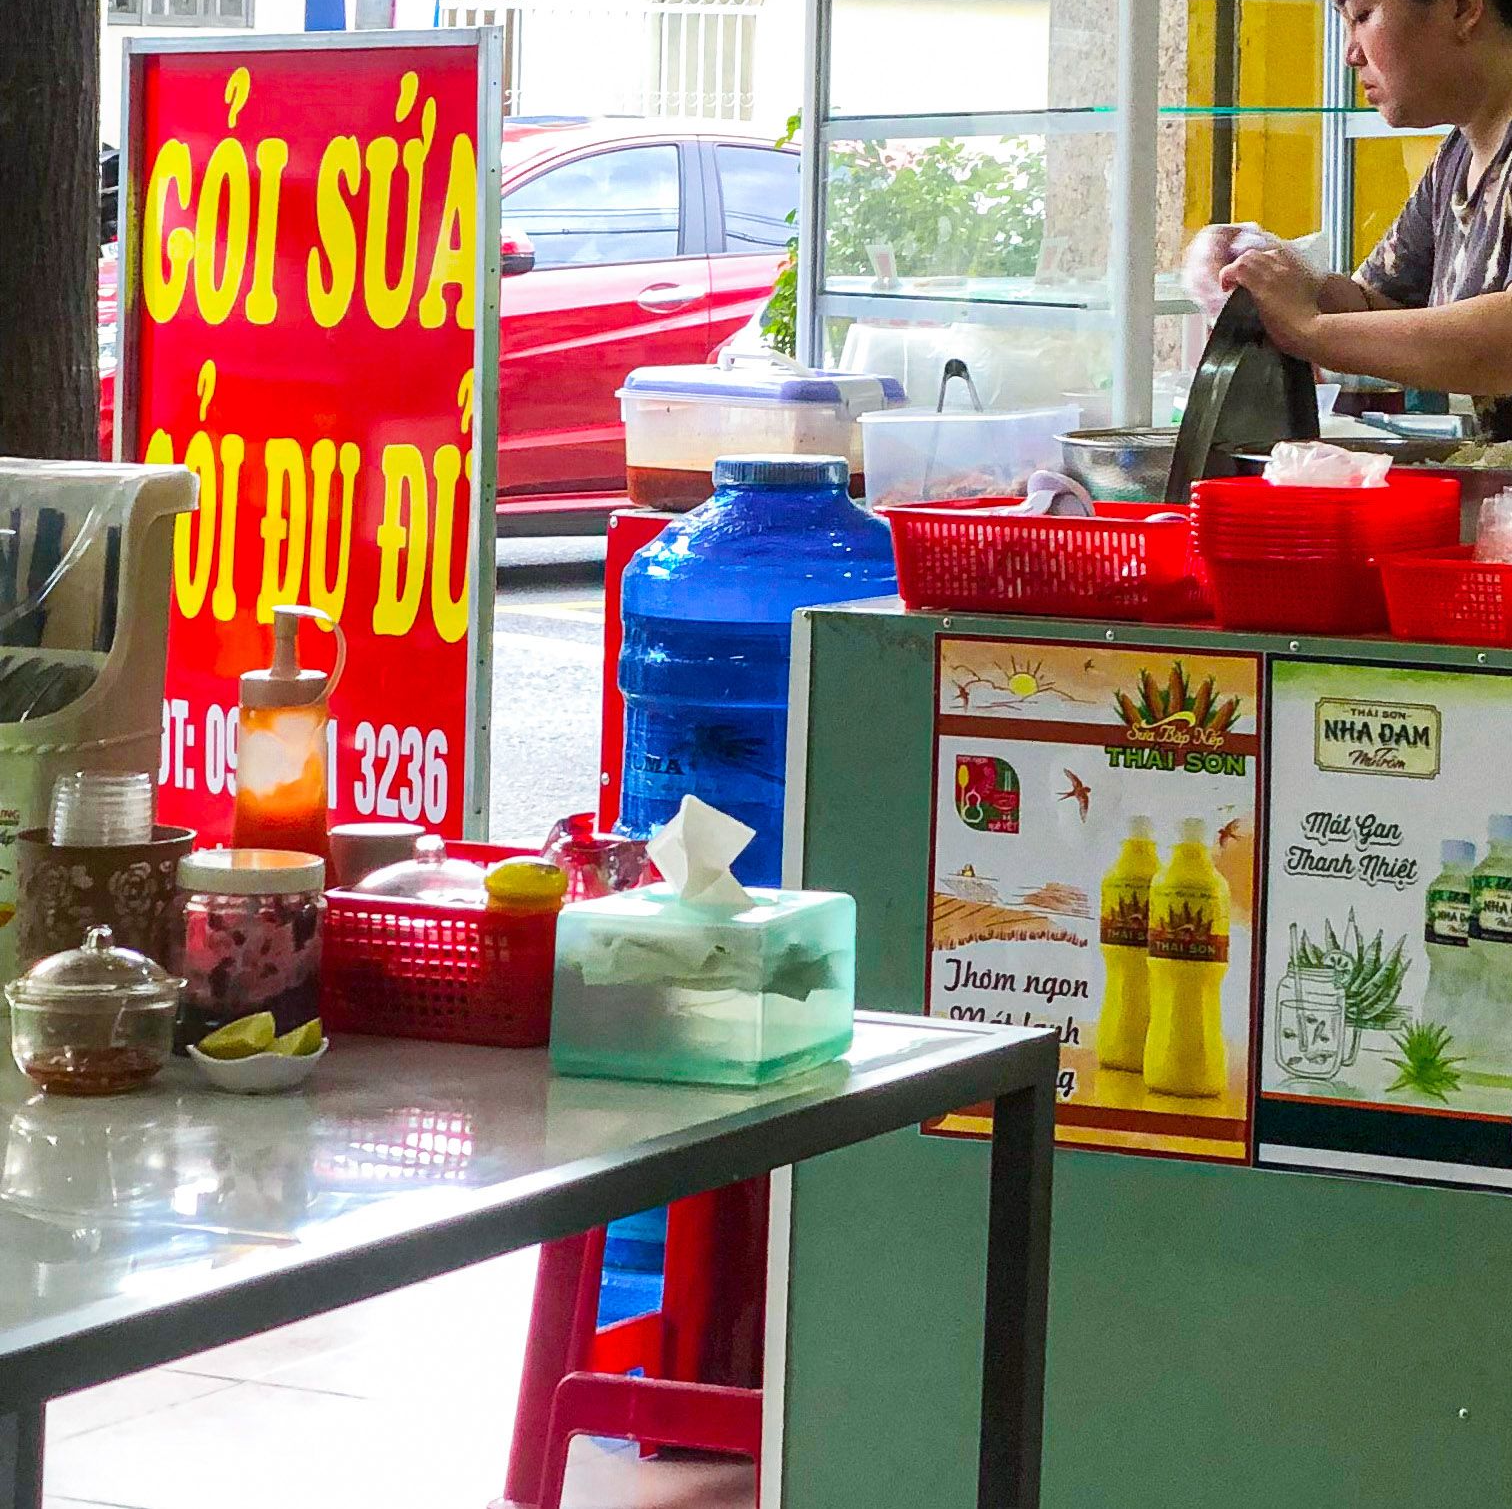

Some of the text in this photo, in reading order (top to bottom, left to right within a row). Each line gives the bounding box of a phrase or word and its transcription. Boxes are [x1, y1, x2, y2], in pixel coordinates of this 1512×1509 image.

[144, 67, 476, 330] GỎI SỨA
[1324, 719, 1374, 746] NHA
[353, 721, 448, 824] 3236
[1106, 744, 1246, 776] THÁI SƠN
[1306, 811, 1402, 845] Mát Gan
[1288, 845, 1418, 885] Thanh Nhiệt
[1023, 975, 1089, 1003] ngon
